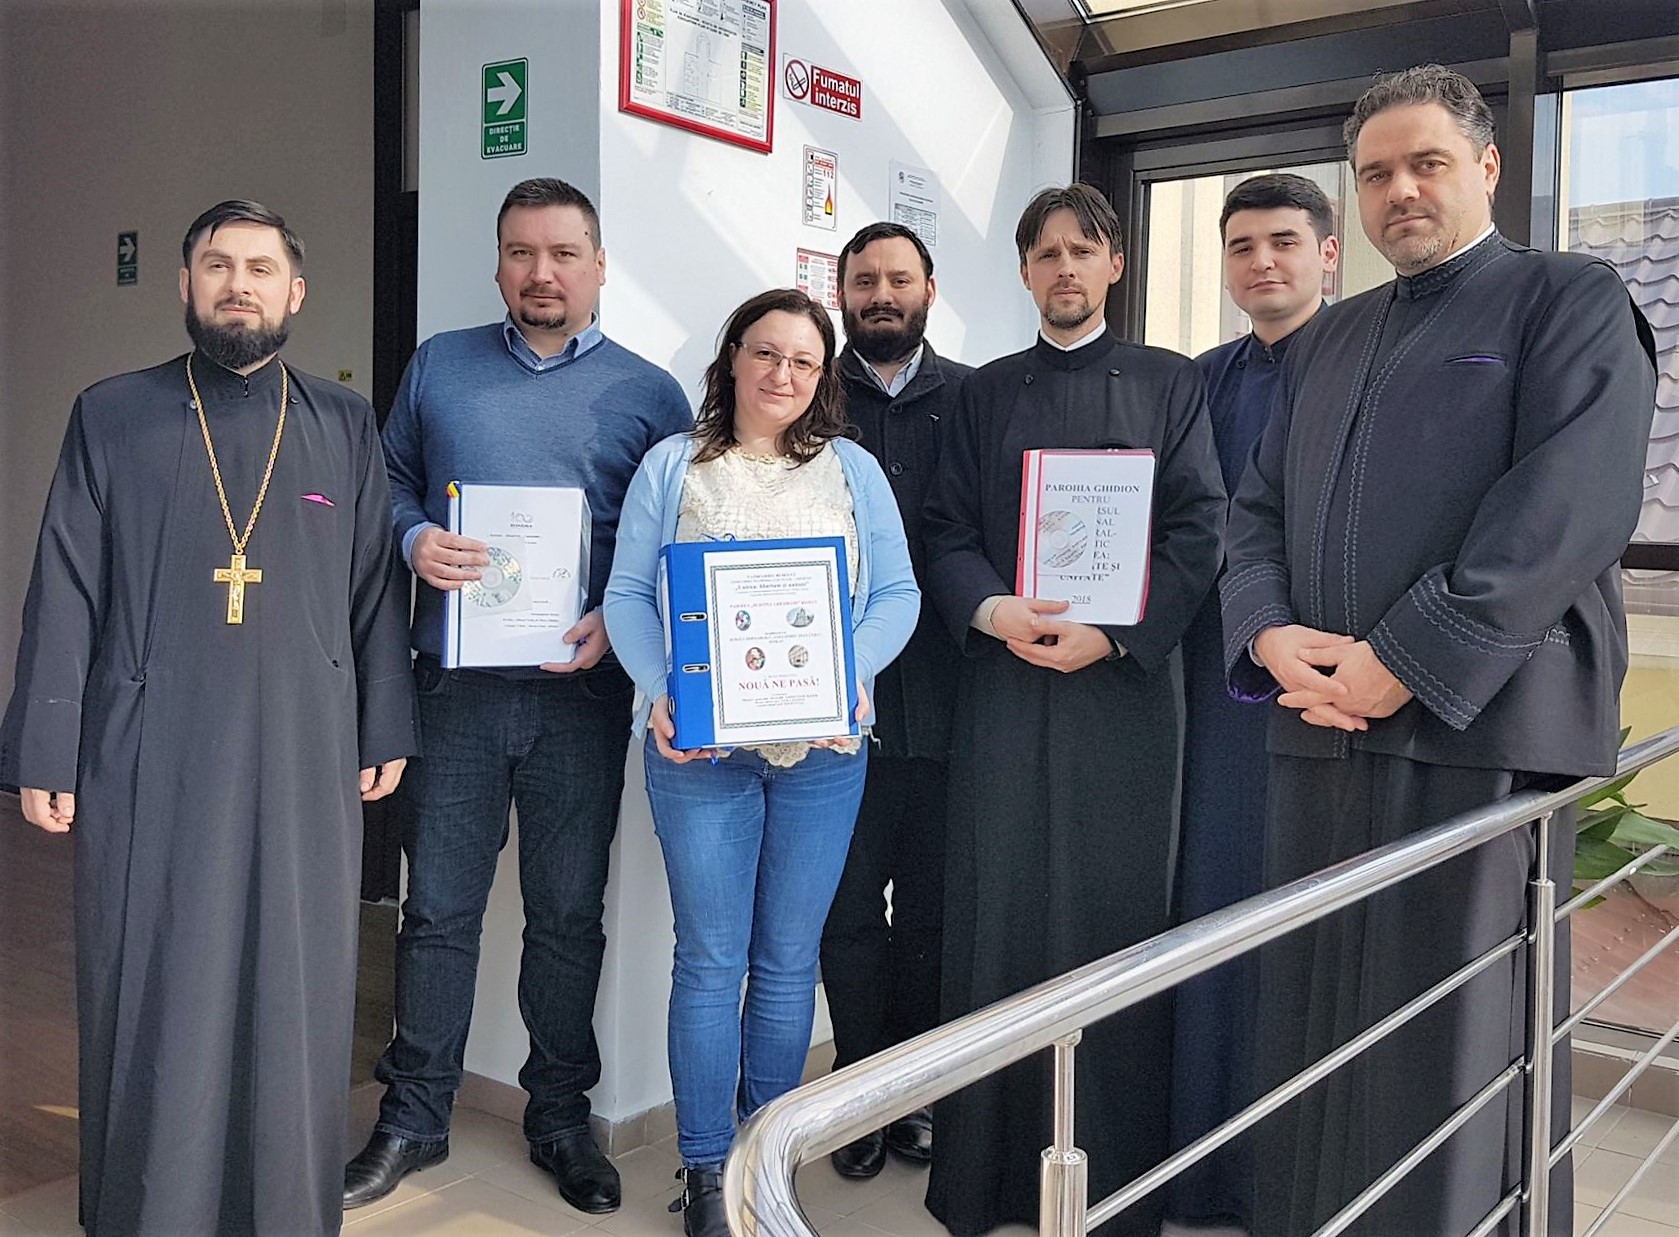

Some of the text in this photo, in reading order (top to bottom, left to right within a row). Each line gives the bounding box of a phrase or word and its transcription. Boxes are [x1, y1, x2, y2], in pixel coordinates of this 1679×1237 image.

[813, 68, 860, 98] Fumatul
[815, 87, 857, 115] interzis
[499, 135, 509, 143] DE
[486, 143, 522, 154] EVACUARE
[1045, 483, 1140, 493] PAROHIA GHIDION
[1071, 495, 1111, 504] PENTRU
[738, 679, 769, 690] NOUĂ
[772, 679, 787, 689] NE
